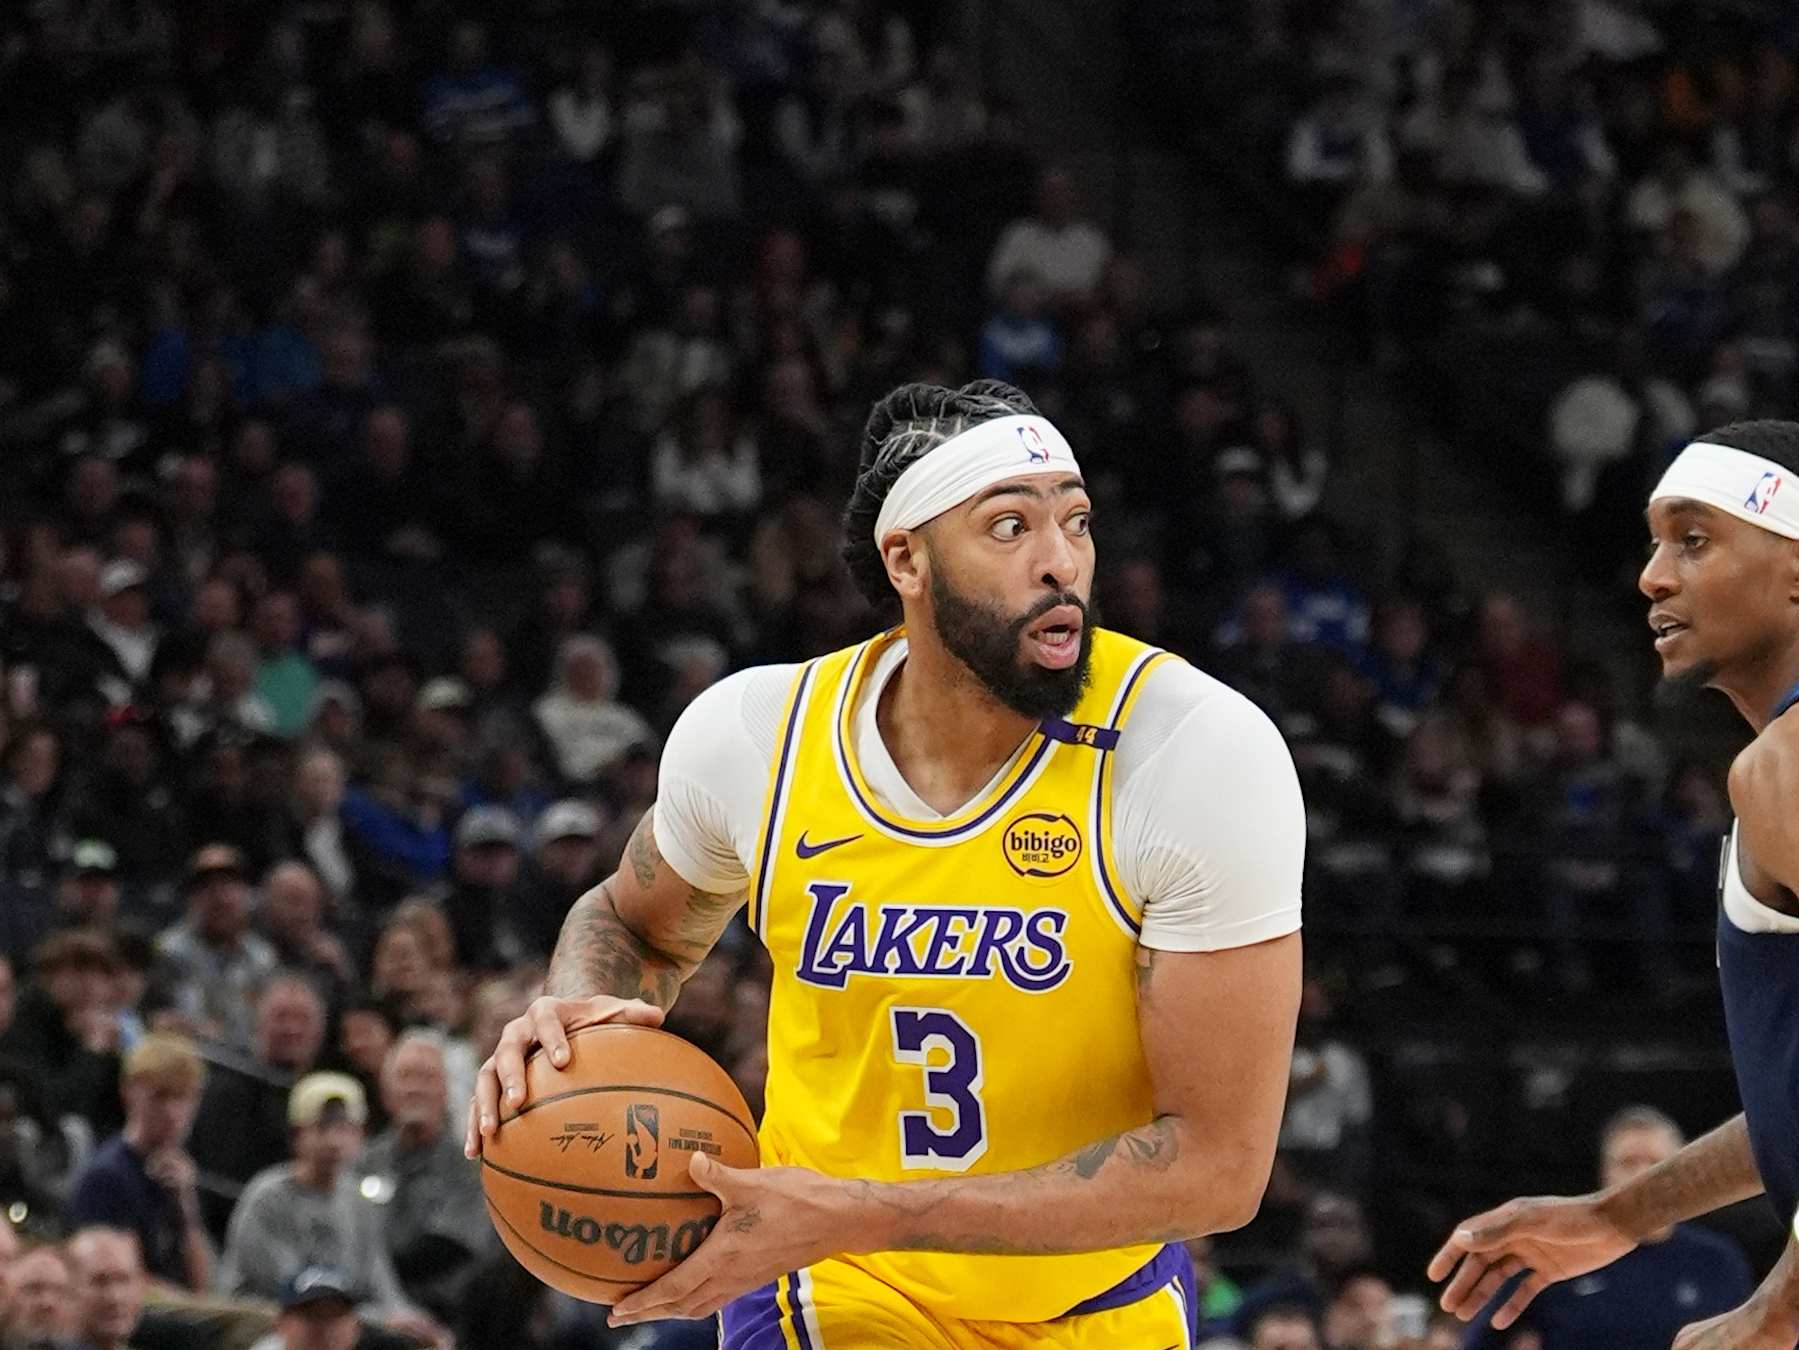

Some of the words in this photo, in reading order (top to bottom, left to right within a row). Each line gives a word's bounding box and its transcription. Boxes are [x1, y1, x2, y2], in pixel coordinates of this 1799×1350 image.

[1010, 830, 1077, 859] bibigo
[1022, 853, 1049, 863] 비비고
[795, 881, 1073, 993] LAKERS
[890, 1006, 988, 1172] 3
